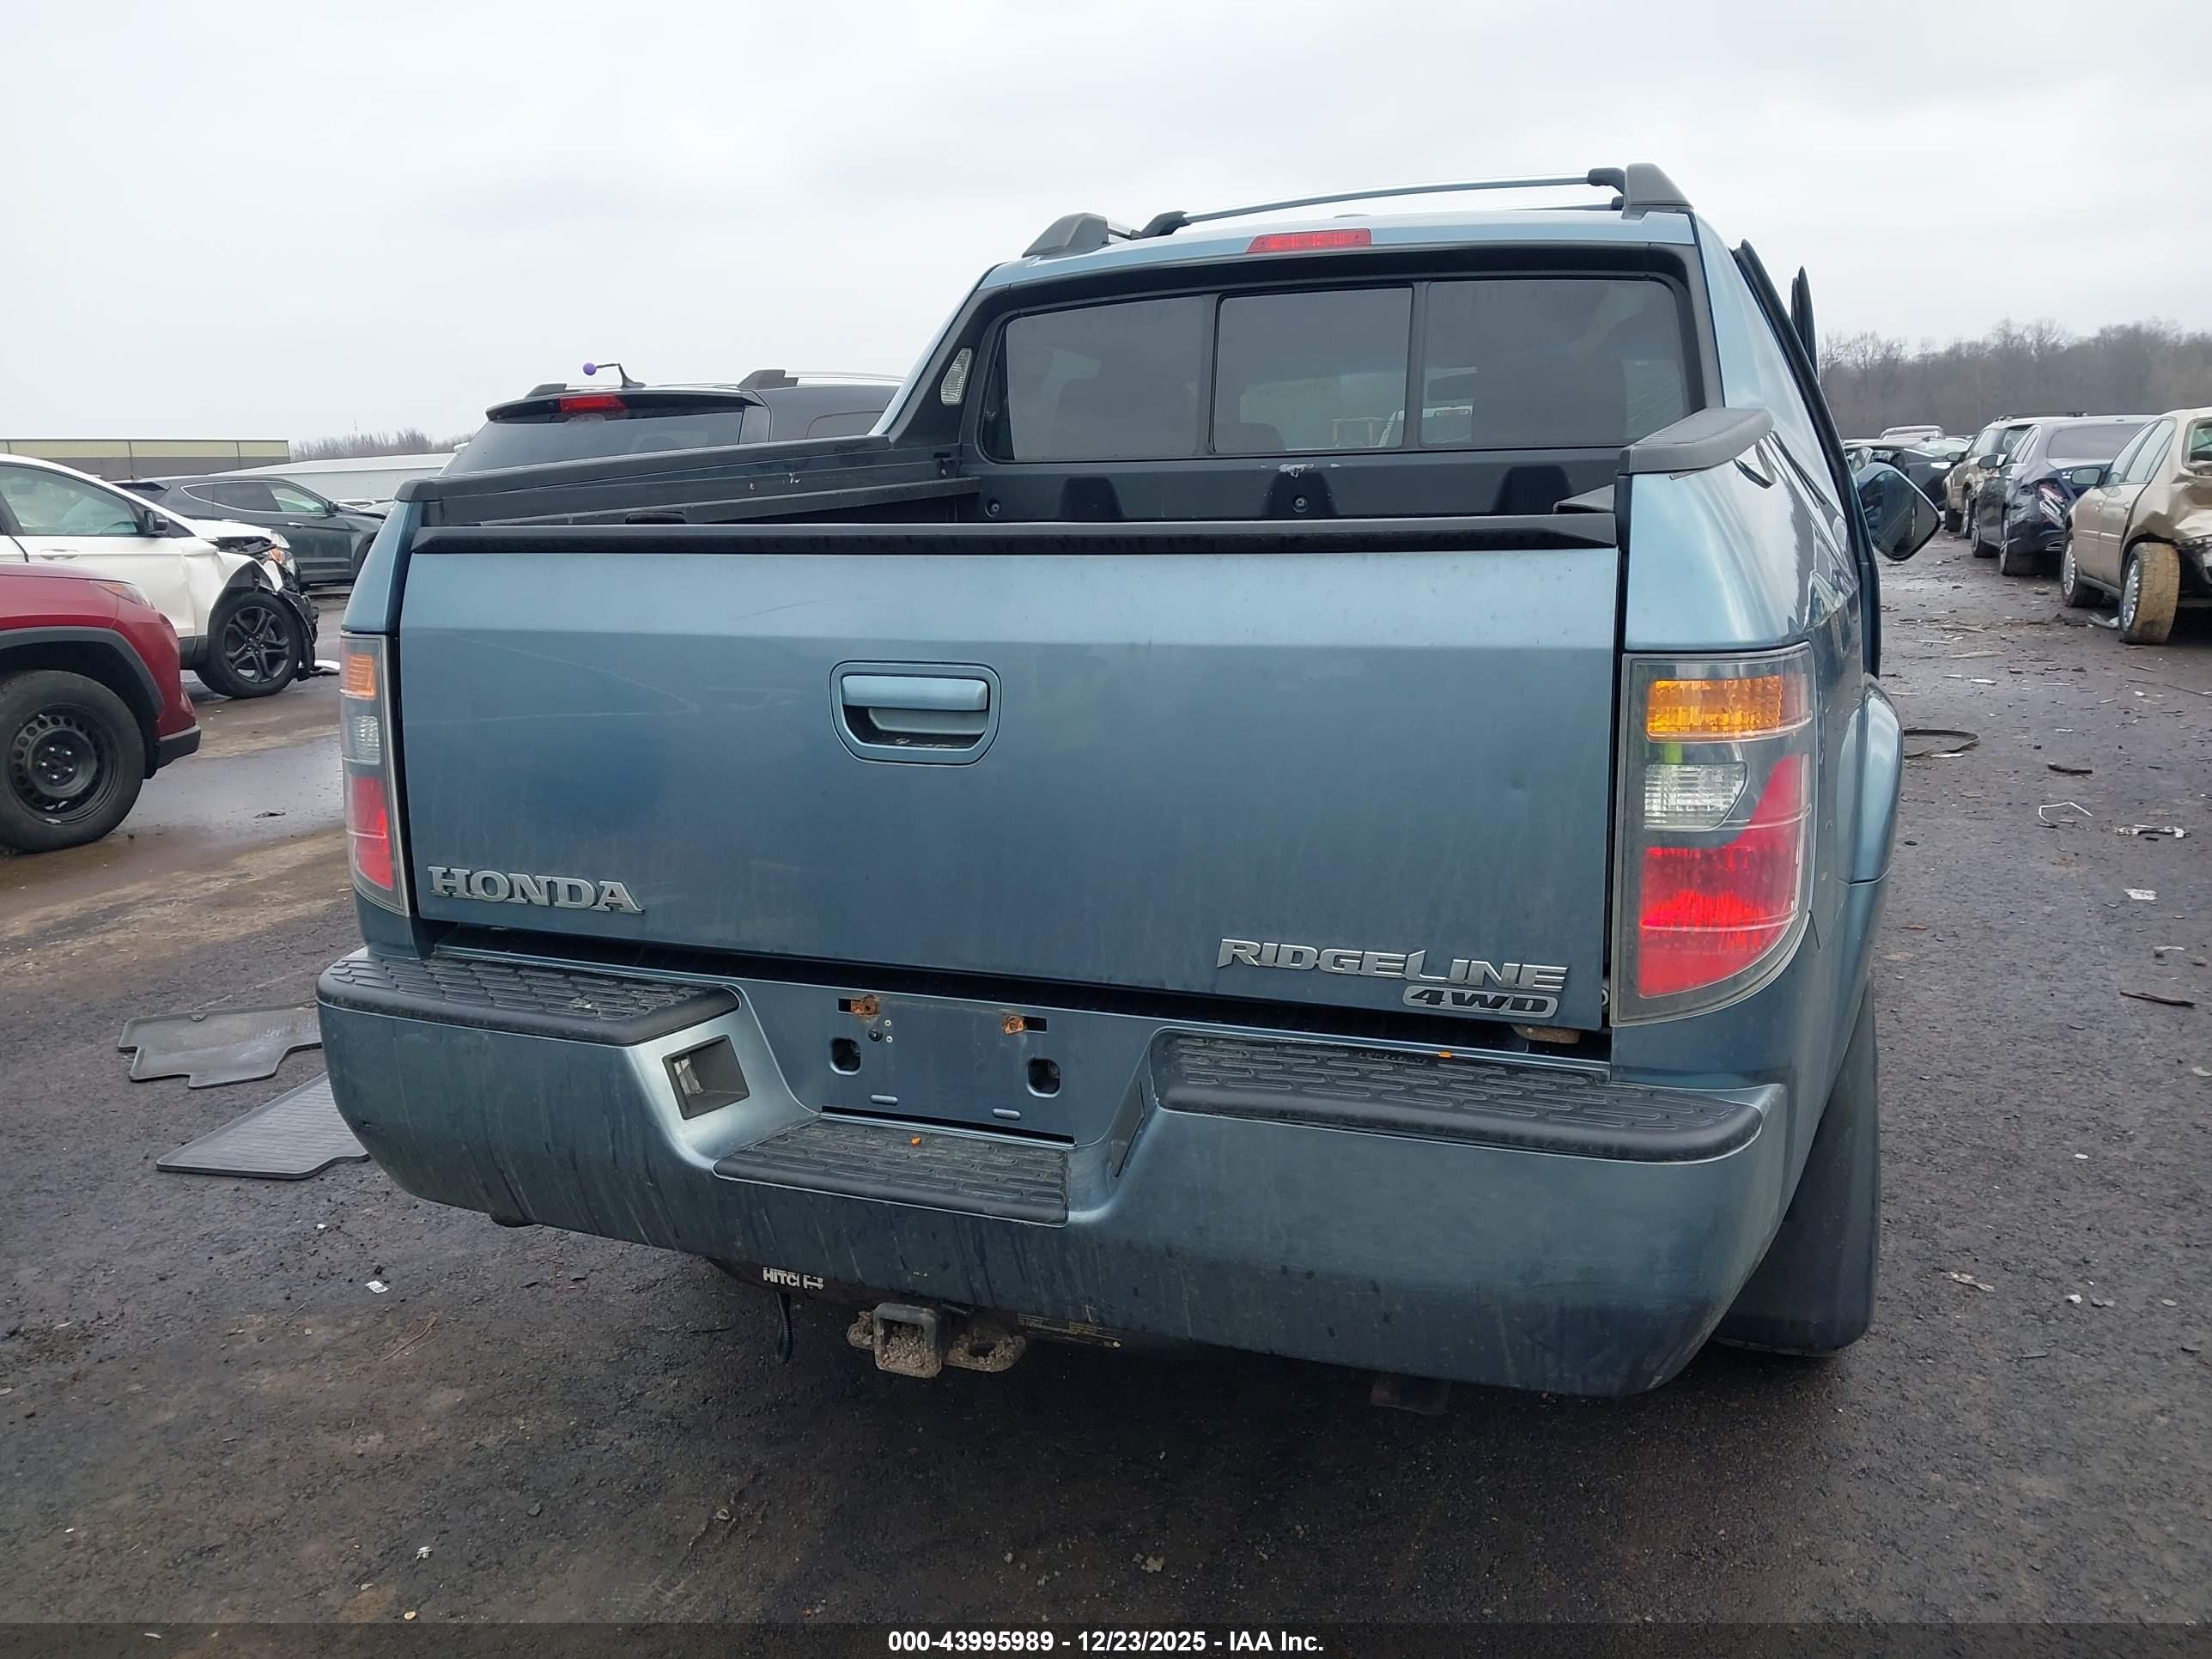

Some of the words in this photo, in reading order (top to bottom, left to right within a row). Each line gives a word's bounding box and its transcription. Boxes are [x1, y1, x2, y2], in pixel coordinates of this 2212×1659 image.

[428, 866, 644, 914] HONDA
[1217, 938, 1569, 991] RIDGELINE
[1410, 989, 1549, 1013] 4WD
